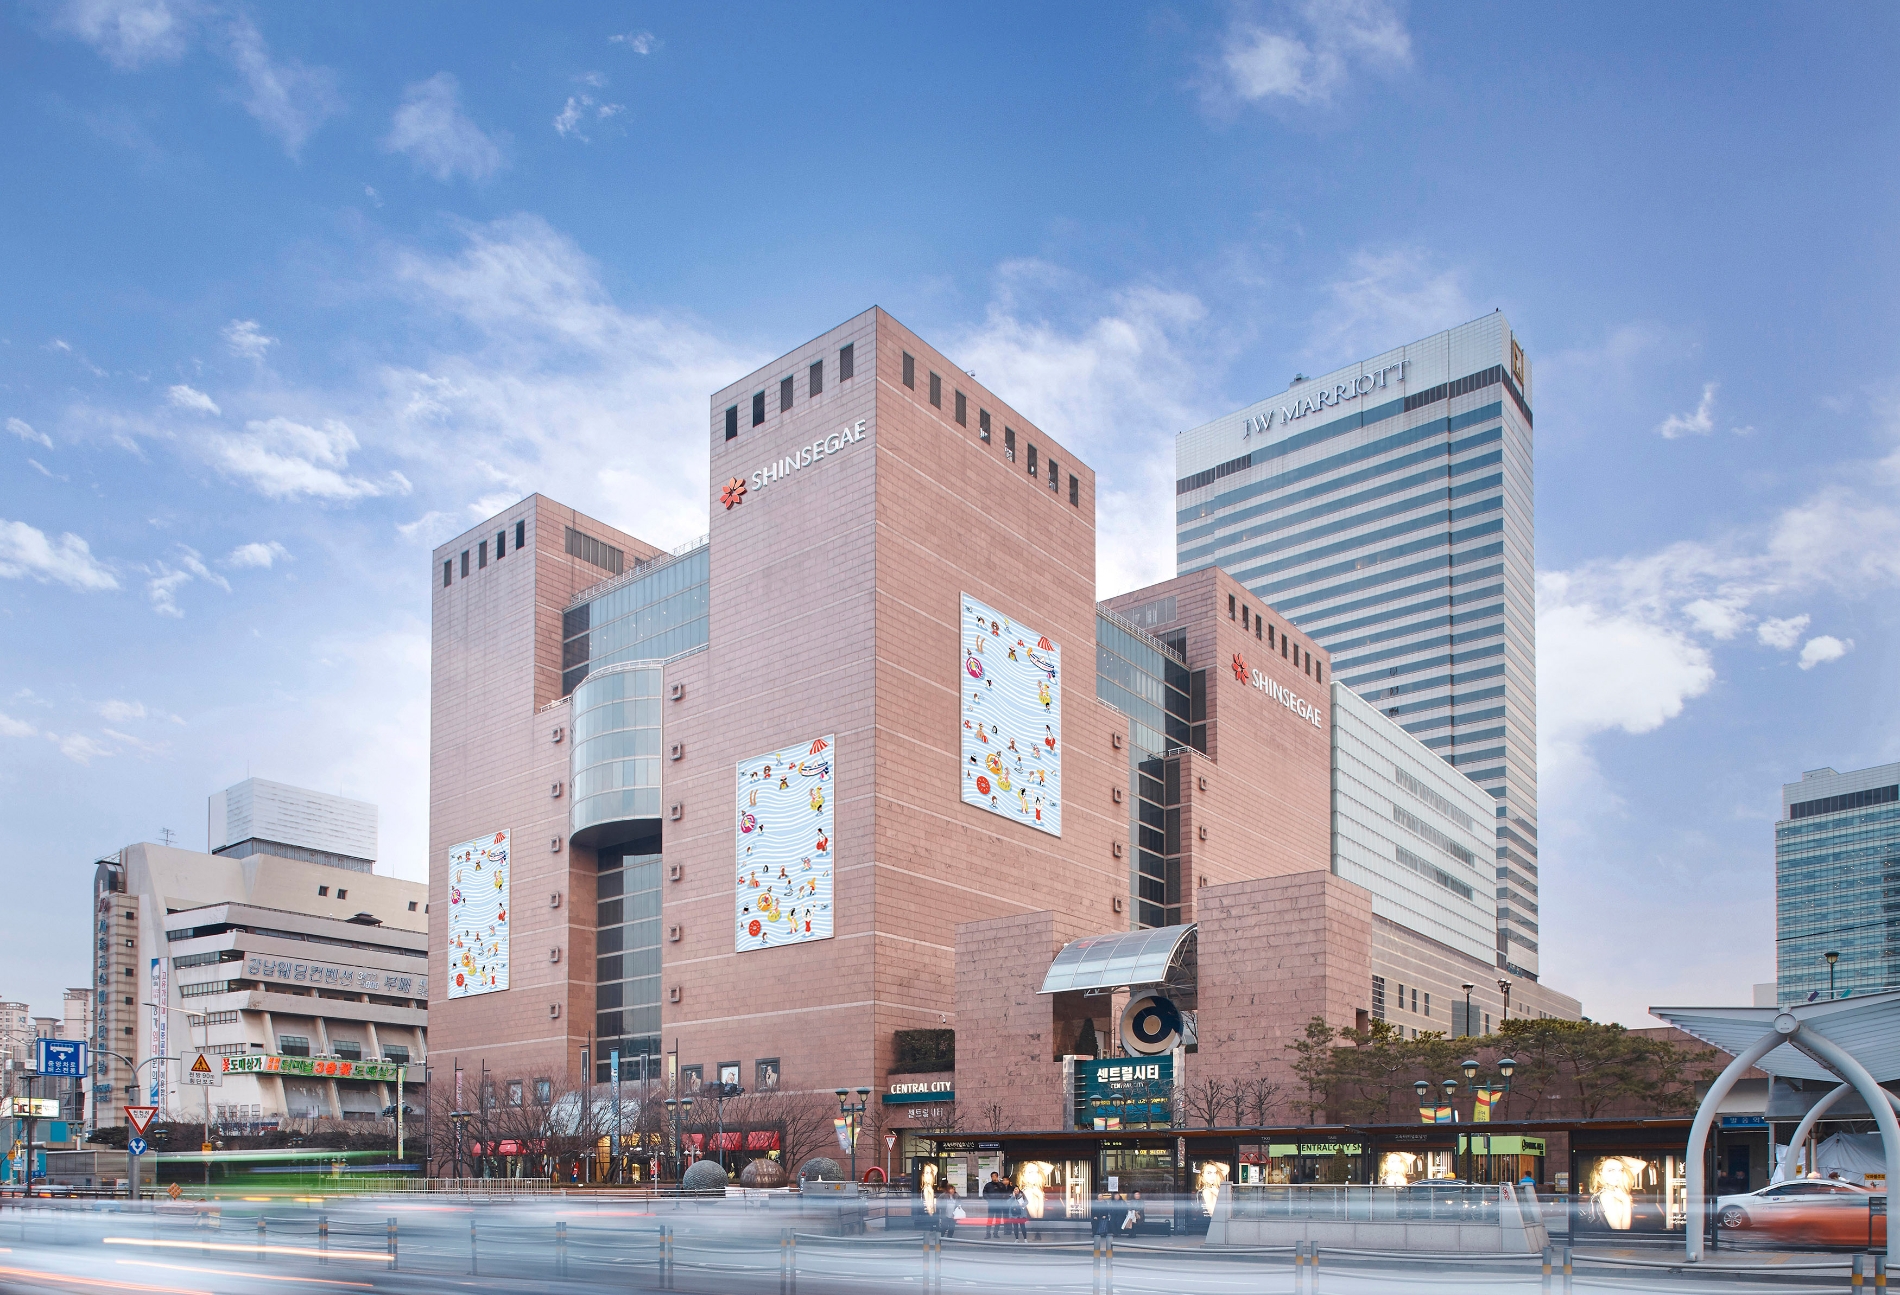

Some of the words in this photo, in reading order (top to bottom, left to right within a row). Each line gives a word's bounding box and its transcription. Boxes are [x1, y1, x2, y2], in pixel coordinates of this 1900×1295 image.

[1242, 409, 1276, 440] JW
[1279, 358, 1410, 425] MARRIOTT
[751, 419, 866, 491] SHINSEGAE
[1251, 668, 1322, 729] SHINSEGAE
[230, 1057, 262, 1071] 도매상가
[280, 1059, 315, 1074] 터미널
[315, 1061, 337, 1075] 3층
[1096, 1065, 1159, 1083] 센트럴시티
[890, 1083, 929, 1094] CENTRAL
[931, 1081, 951, 1092] CITY
